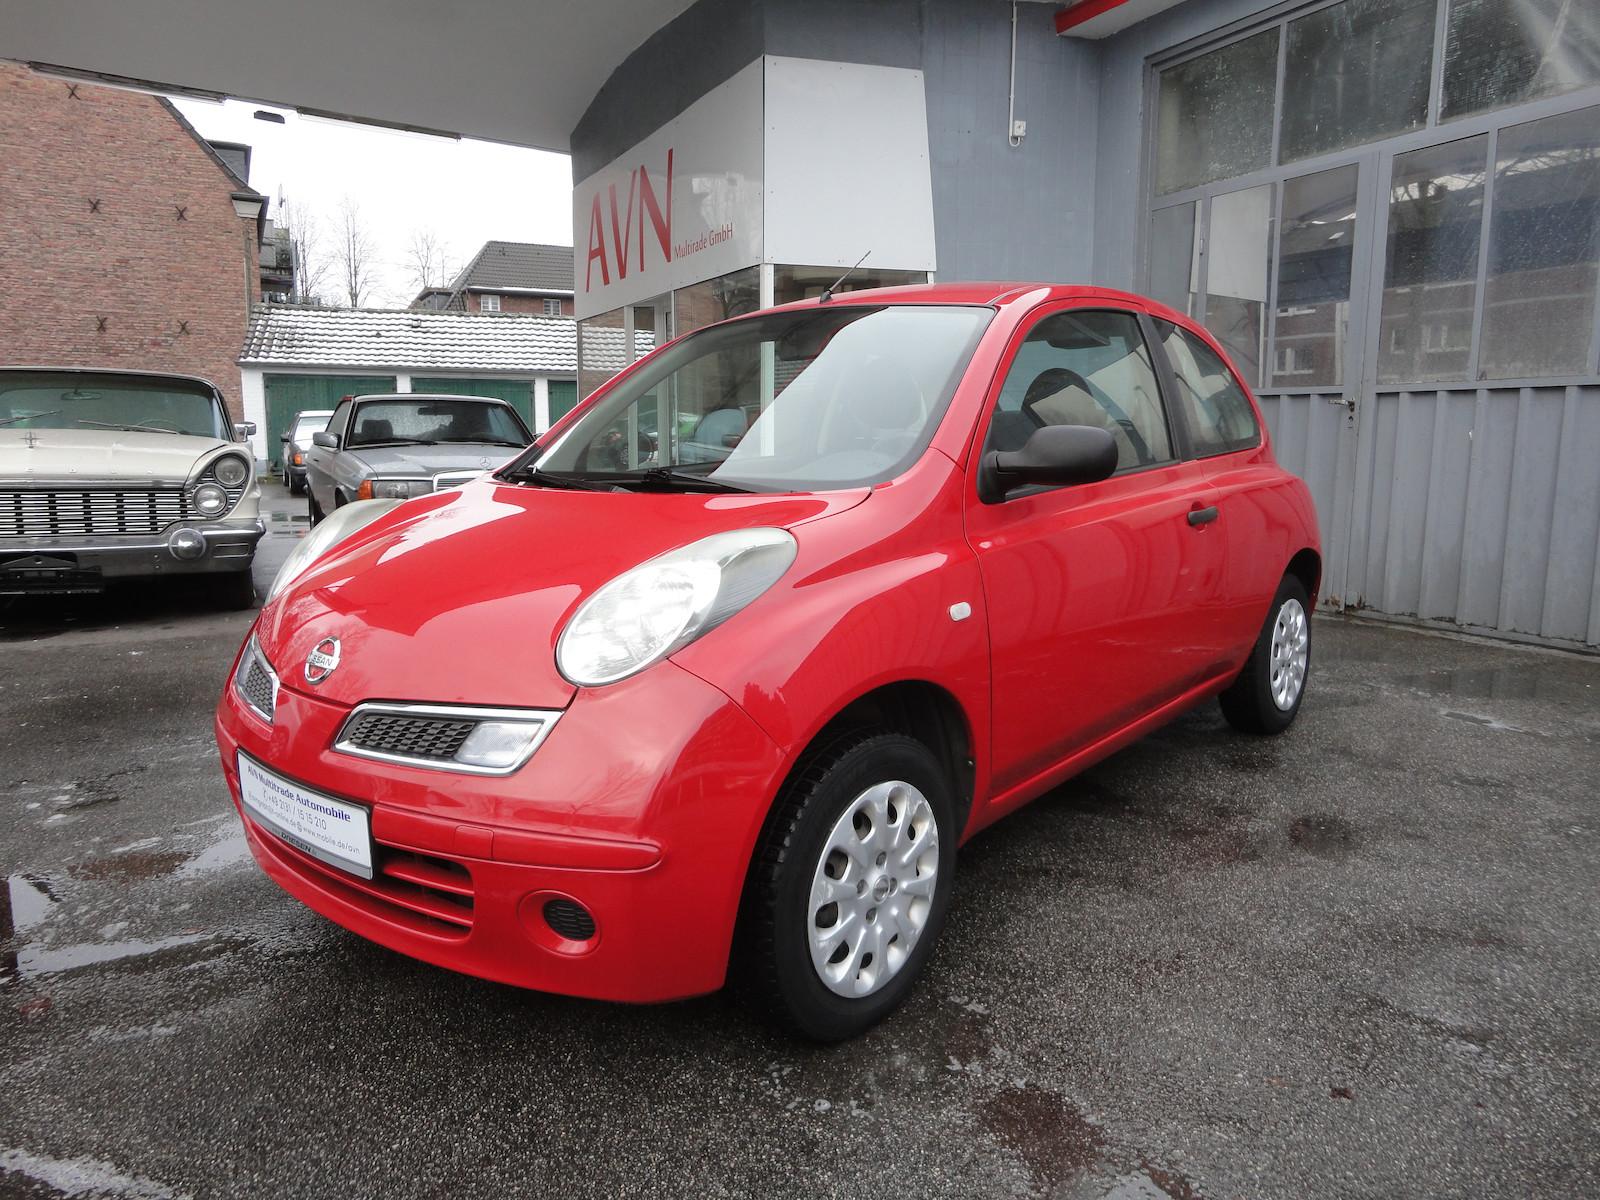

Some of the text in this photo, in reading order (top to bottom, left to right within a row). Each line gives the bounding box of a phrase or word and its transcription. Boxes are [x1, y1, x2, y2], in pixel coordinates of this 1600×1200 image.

[586, 148, 673, 293] AVN
[709, 222, 733, 247] GmbH
[258, 772, 295, 801] Multitrade
[296, 793, 351, 822] Automobile
[297, 808, 305, 821] 15
[306, 812, 314, 825] 15
[315, 816, 327, 831] 210
